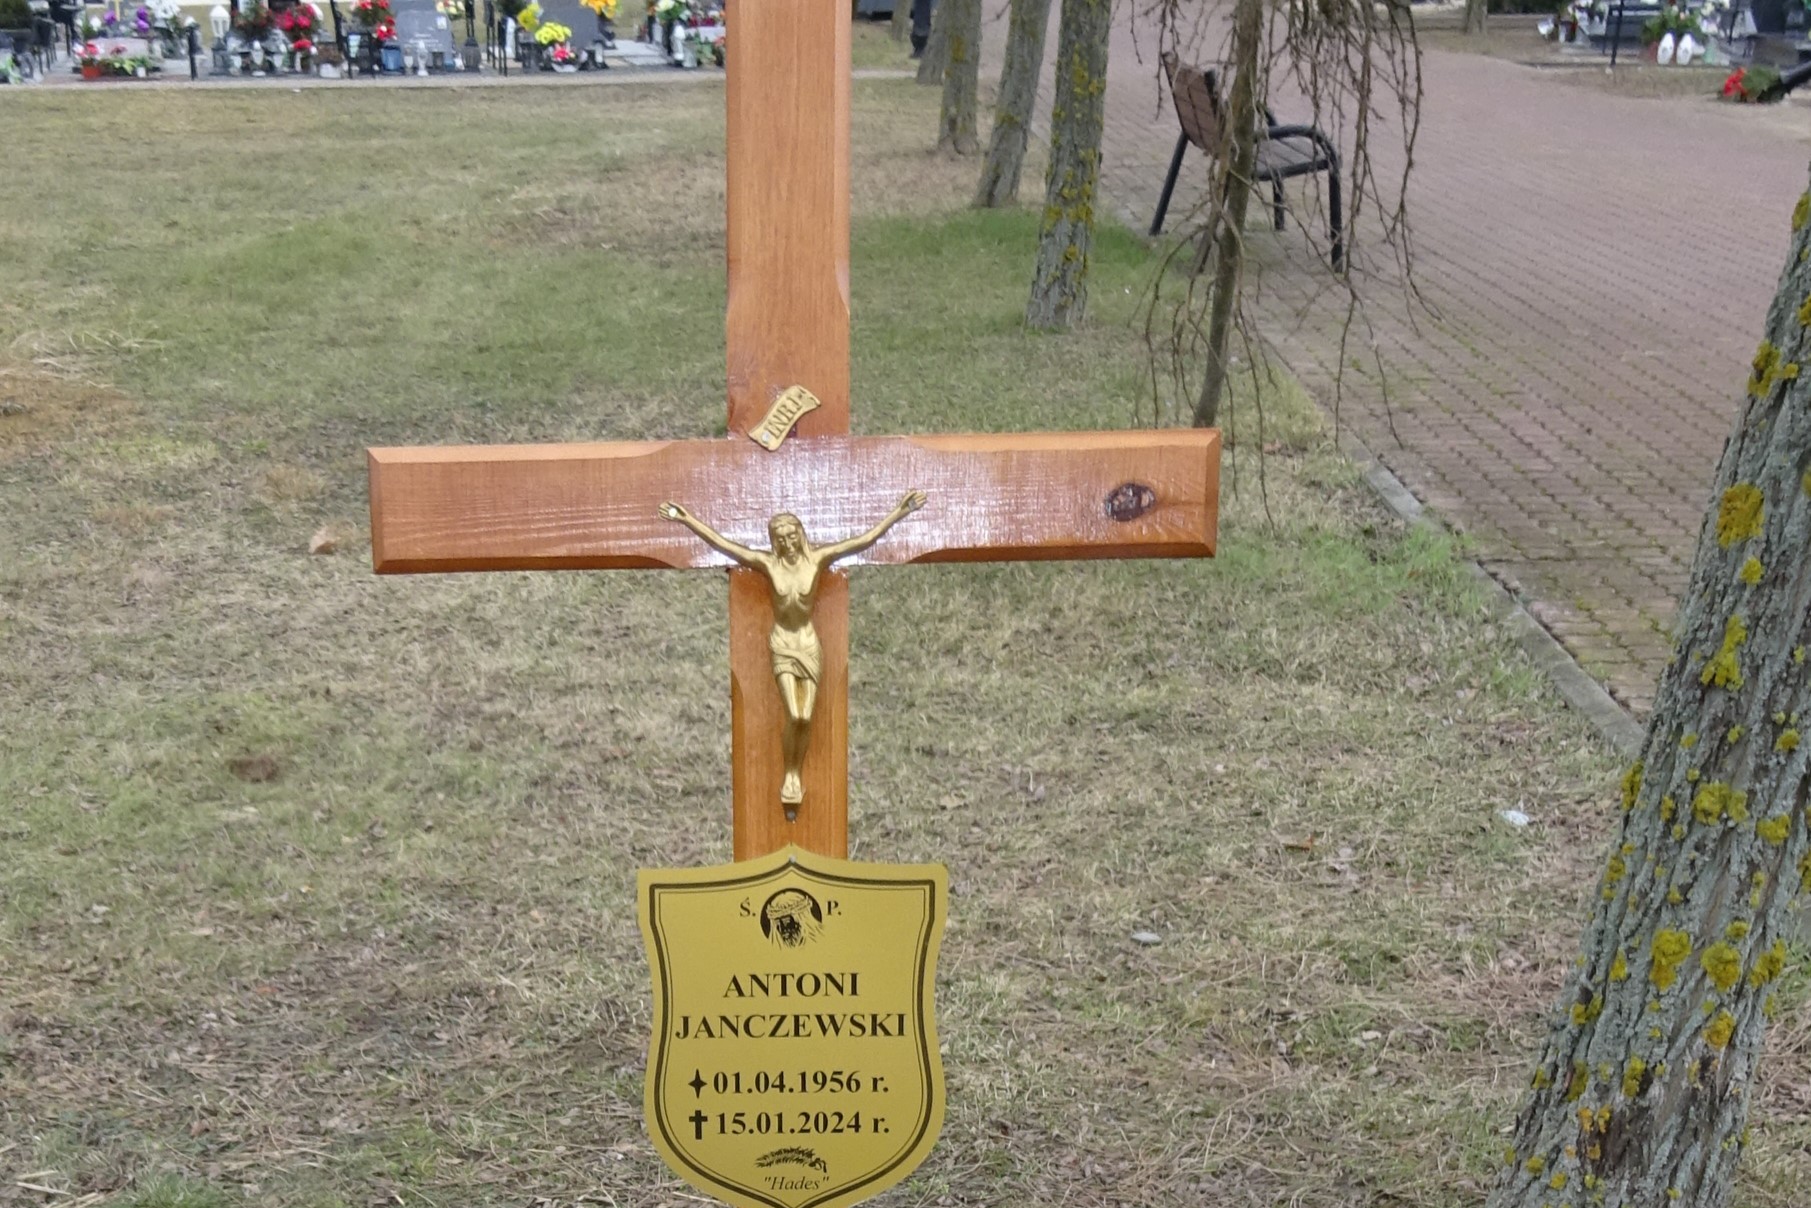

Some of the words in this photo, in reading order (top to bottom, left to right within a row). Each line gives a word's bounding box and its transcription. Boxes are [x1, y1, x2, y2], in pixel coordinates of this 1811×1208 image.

[763, 396, 804, 441] INRI
[739, 896, 757, 917] Ś.
[826, 900, 842, 916] P.
[723, 972, 860, 998] ANTONI
[675, 1013, 907, 1039] JANCZEWSKI
[713, 1070, 862, 1094] 01.04.1956
[871, 1076, 889, 1093] r.
[716, 1111, 862, 1135] 15.01.2024
[872, 1117, 890, 1134] r.
